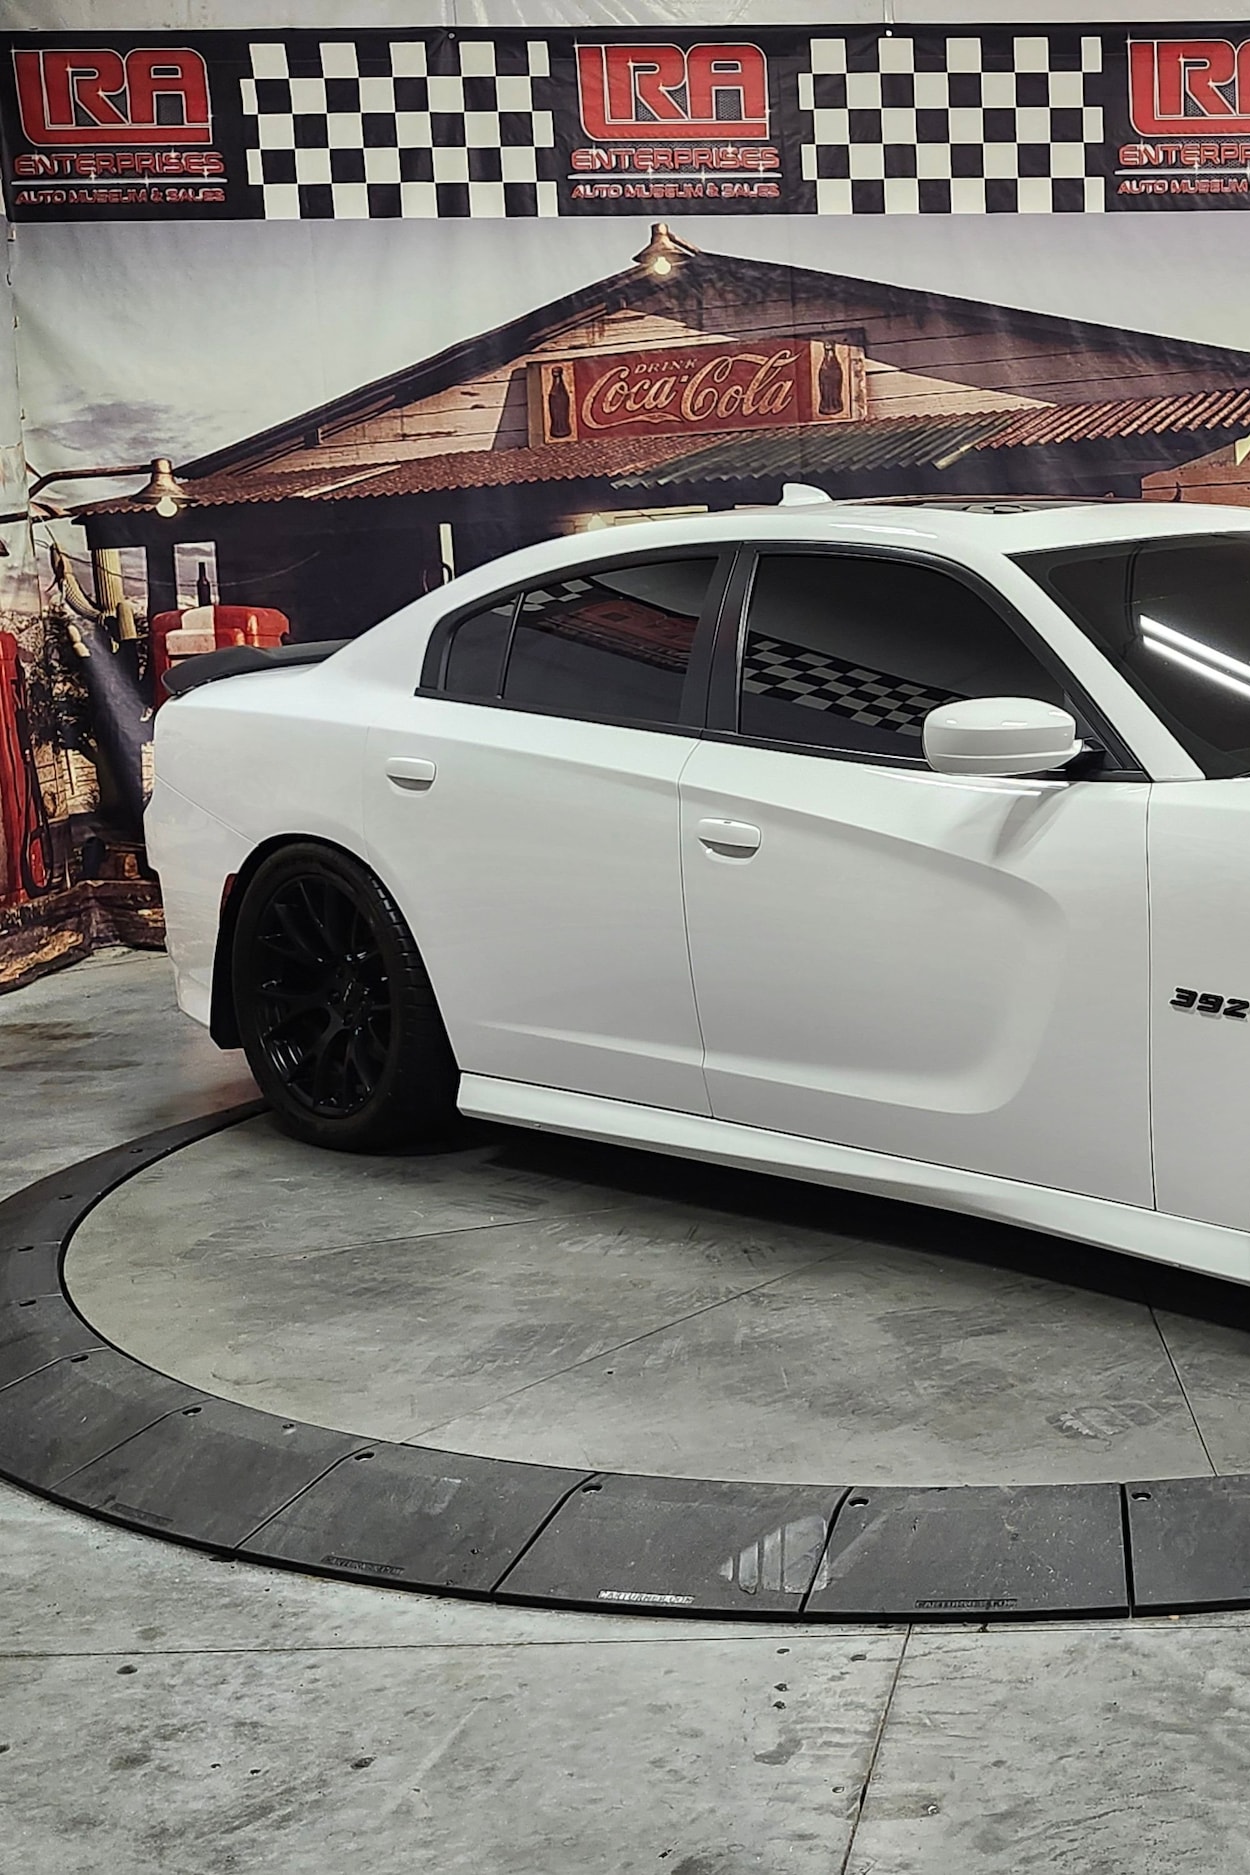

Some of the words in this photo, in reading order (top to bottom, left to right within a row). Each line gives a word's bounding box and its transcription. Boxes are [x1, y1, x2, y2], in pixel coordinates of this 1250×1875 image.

[13, 48, 213, 147] LRA
[575, 43, 770, 141] LRA
[14, 152, 225, 175] ENTERPRISES
[571, 147, 780, 170] ENTERPRISES
[15, 189, 66, 205] AUTO
[69, 189, 147, 204] MUSEUM
[151, 188, 163, 203] &
[165, 188, 226, 203] SALES
[571, 184, 623, 198] AUTO
[625, 183, 703, 198] MUSEUM
[706, 183, 719, 197] &
[721, 183, 780, 197] SALES
[1117, 179, 1168, 194] AUTO
[1170, 179, 1248, 194] MUSEUM
[634, 358, 698, 374] DRINK
[581, 349, 801, 429] Coca-Cola
[1169, 987, 1250, 1019] 392
